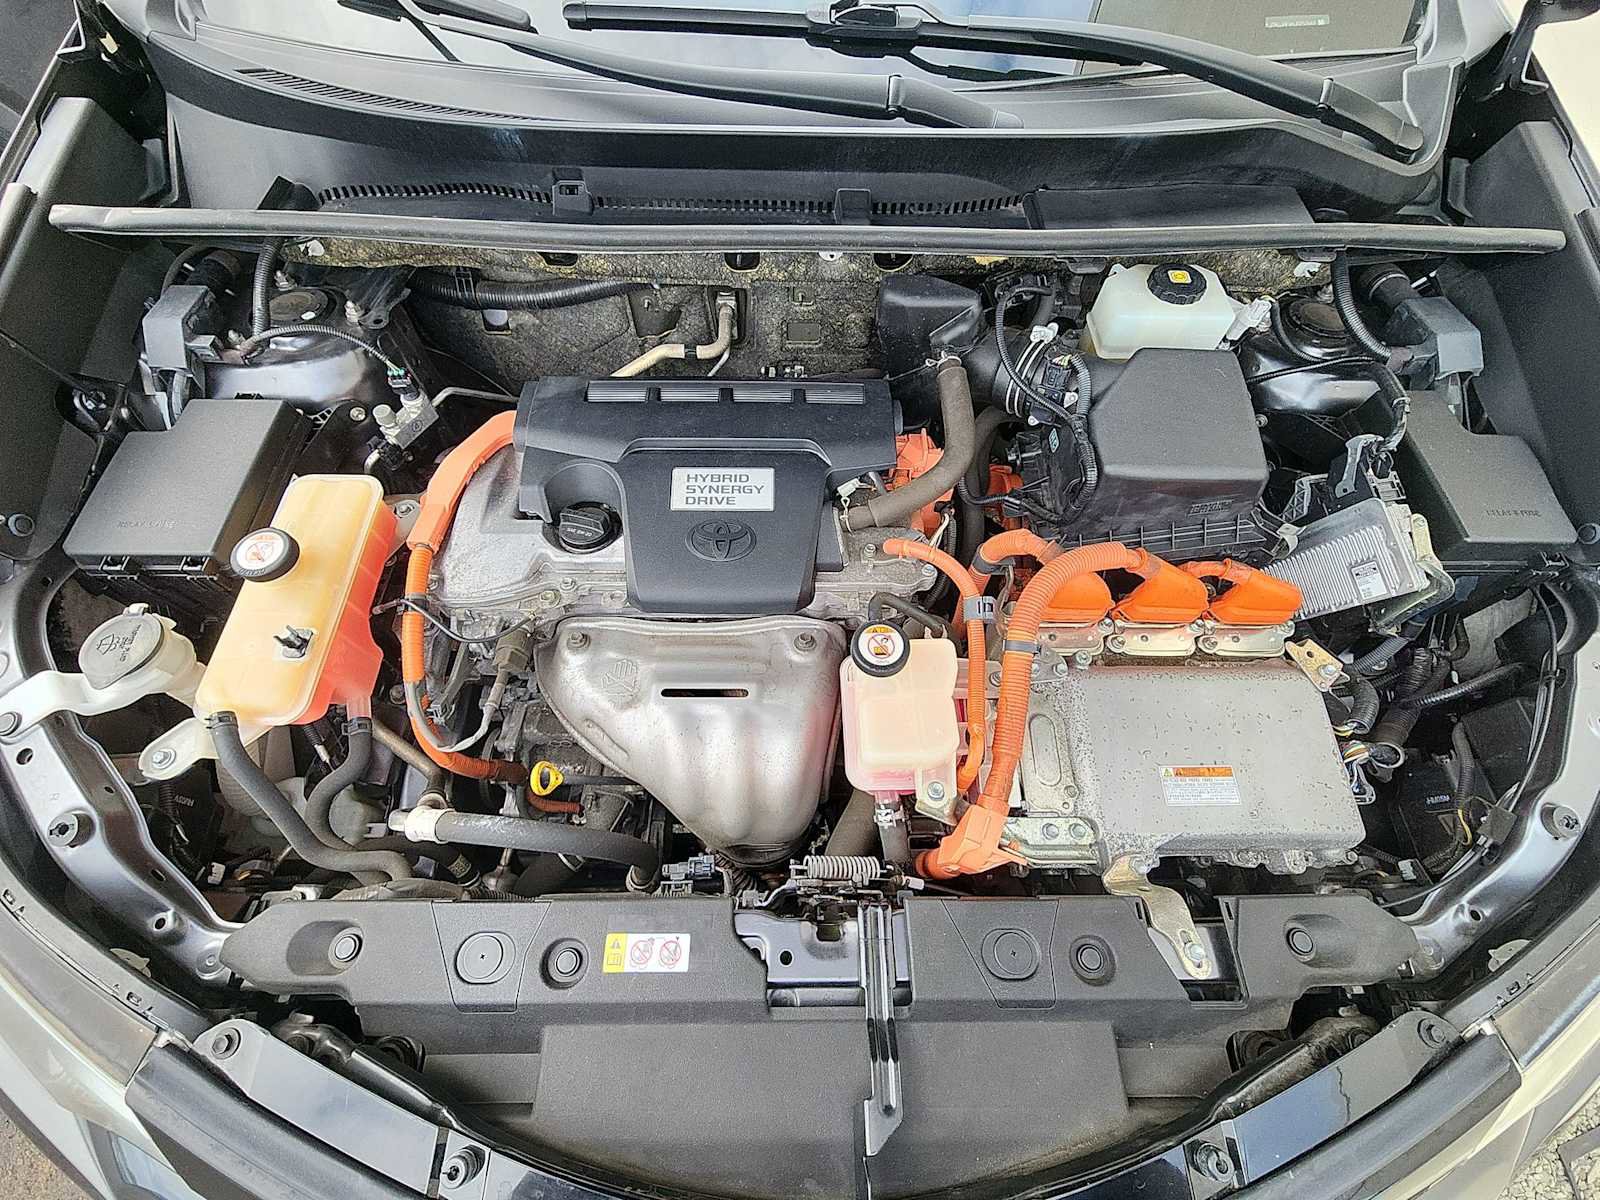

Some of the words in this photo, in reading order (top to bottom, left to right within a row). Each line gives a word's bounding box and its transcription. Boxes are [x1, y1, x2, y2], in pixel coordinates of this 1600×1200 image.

[687, 474, 749, 483] HYBRID
[686, 485, 764, 494] SYNERGY
[685, 496, 736, 505] DRIVE
